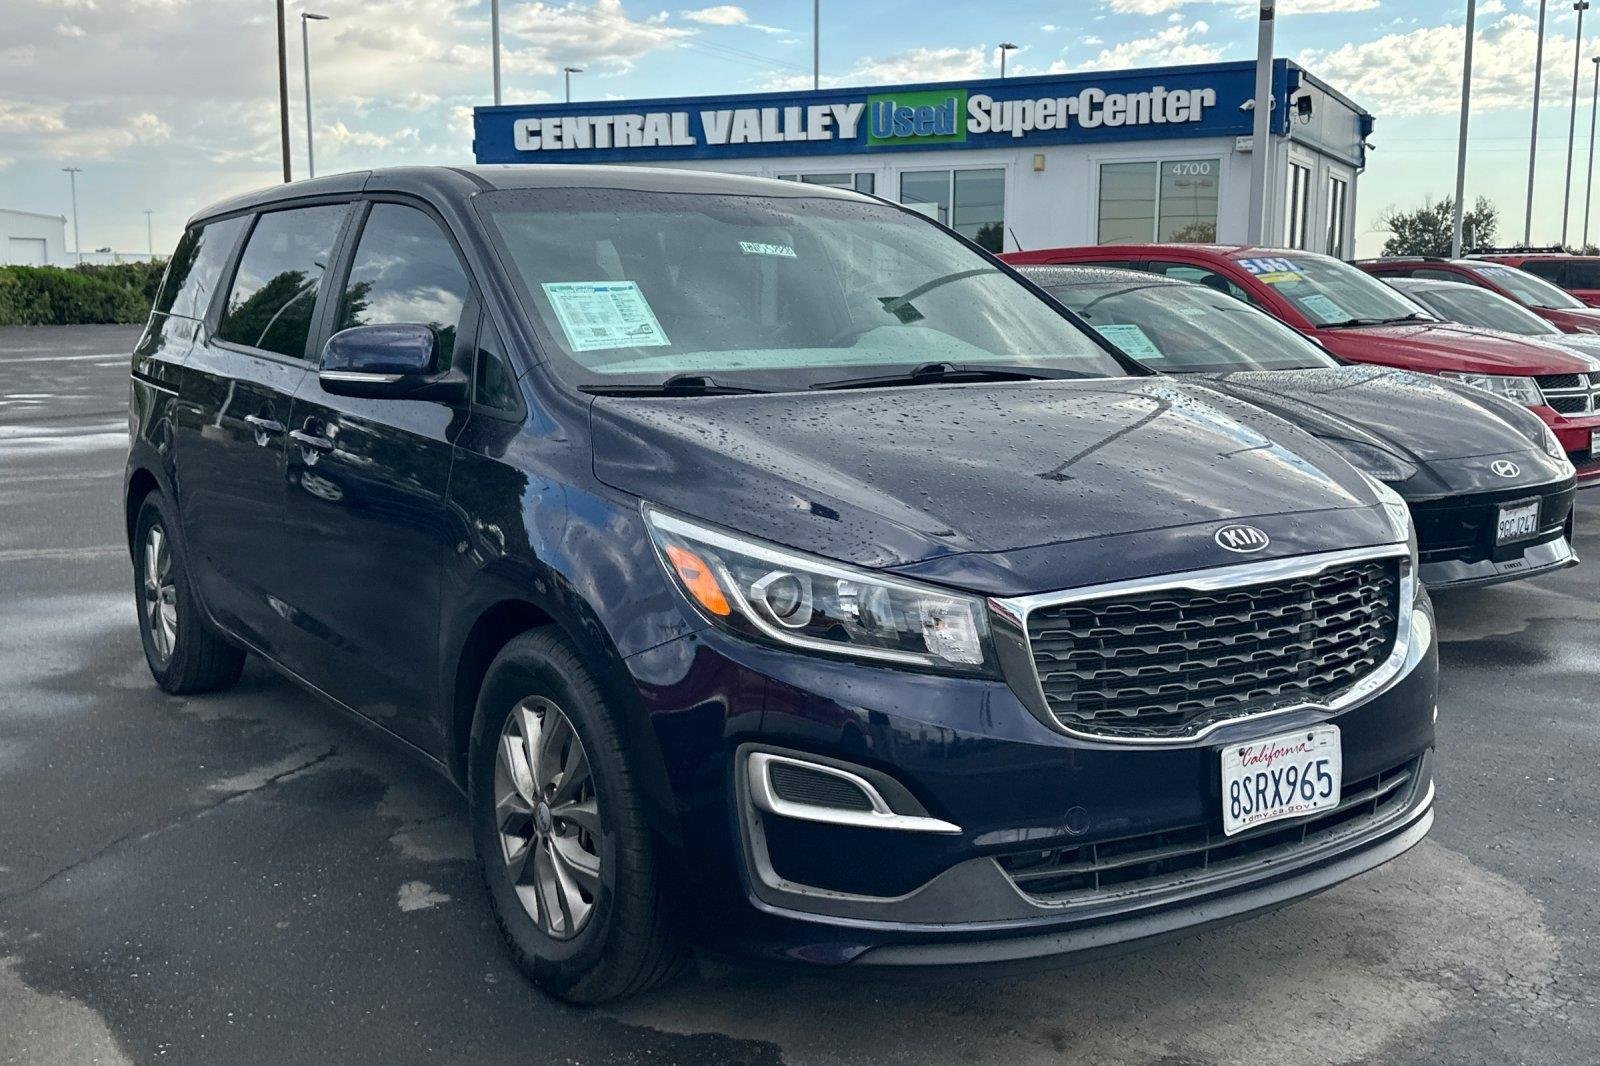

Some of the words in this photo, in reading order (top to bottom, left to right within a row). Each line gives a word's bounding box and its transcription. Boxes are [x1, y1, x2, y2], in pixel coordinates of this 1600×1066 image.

[513, 111, 696, 151] CENTRAL
[700, 103, 866, 145] VALLEY
[871, 97, 958, 139] Used
[967, 85, 1216, 137] SuperCenter
[1172, 162, 1210, 175] 4700
[1222, 528, 1265, 547] KIA
[1242, 743, 1313, 767] California
[1230, 759, 1333, 820] 8SRX965
[1248, 803, 1310, 823] dmv.ca.gov
